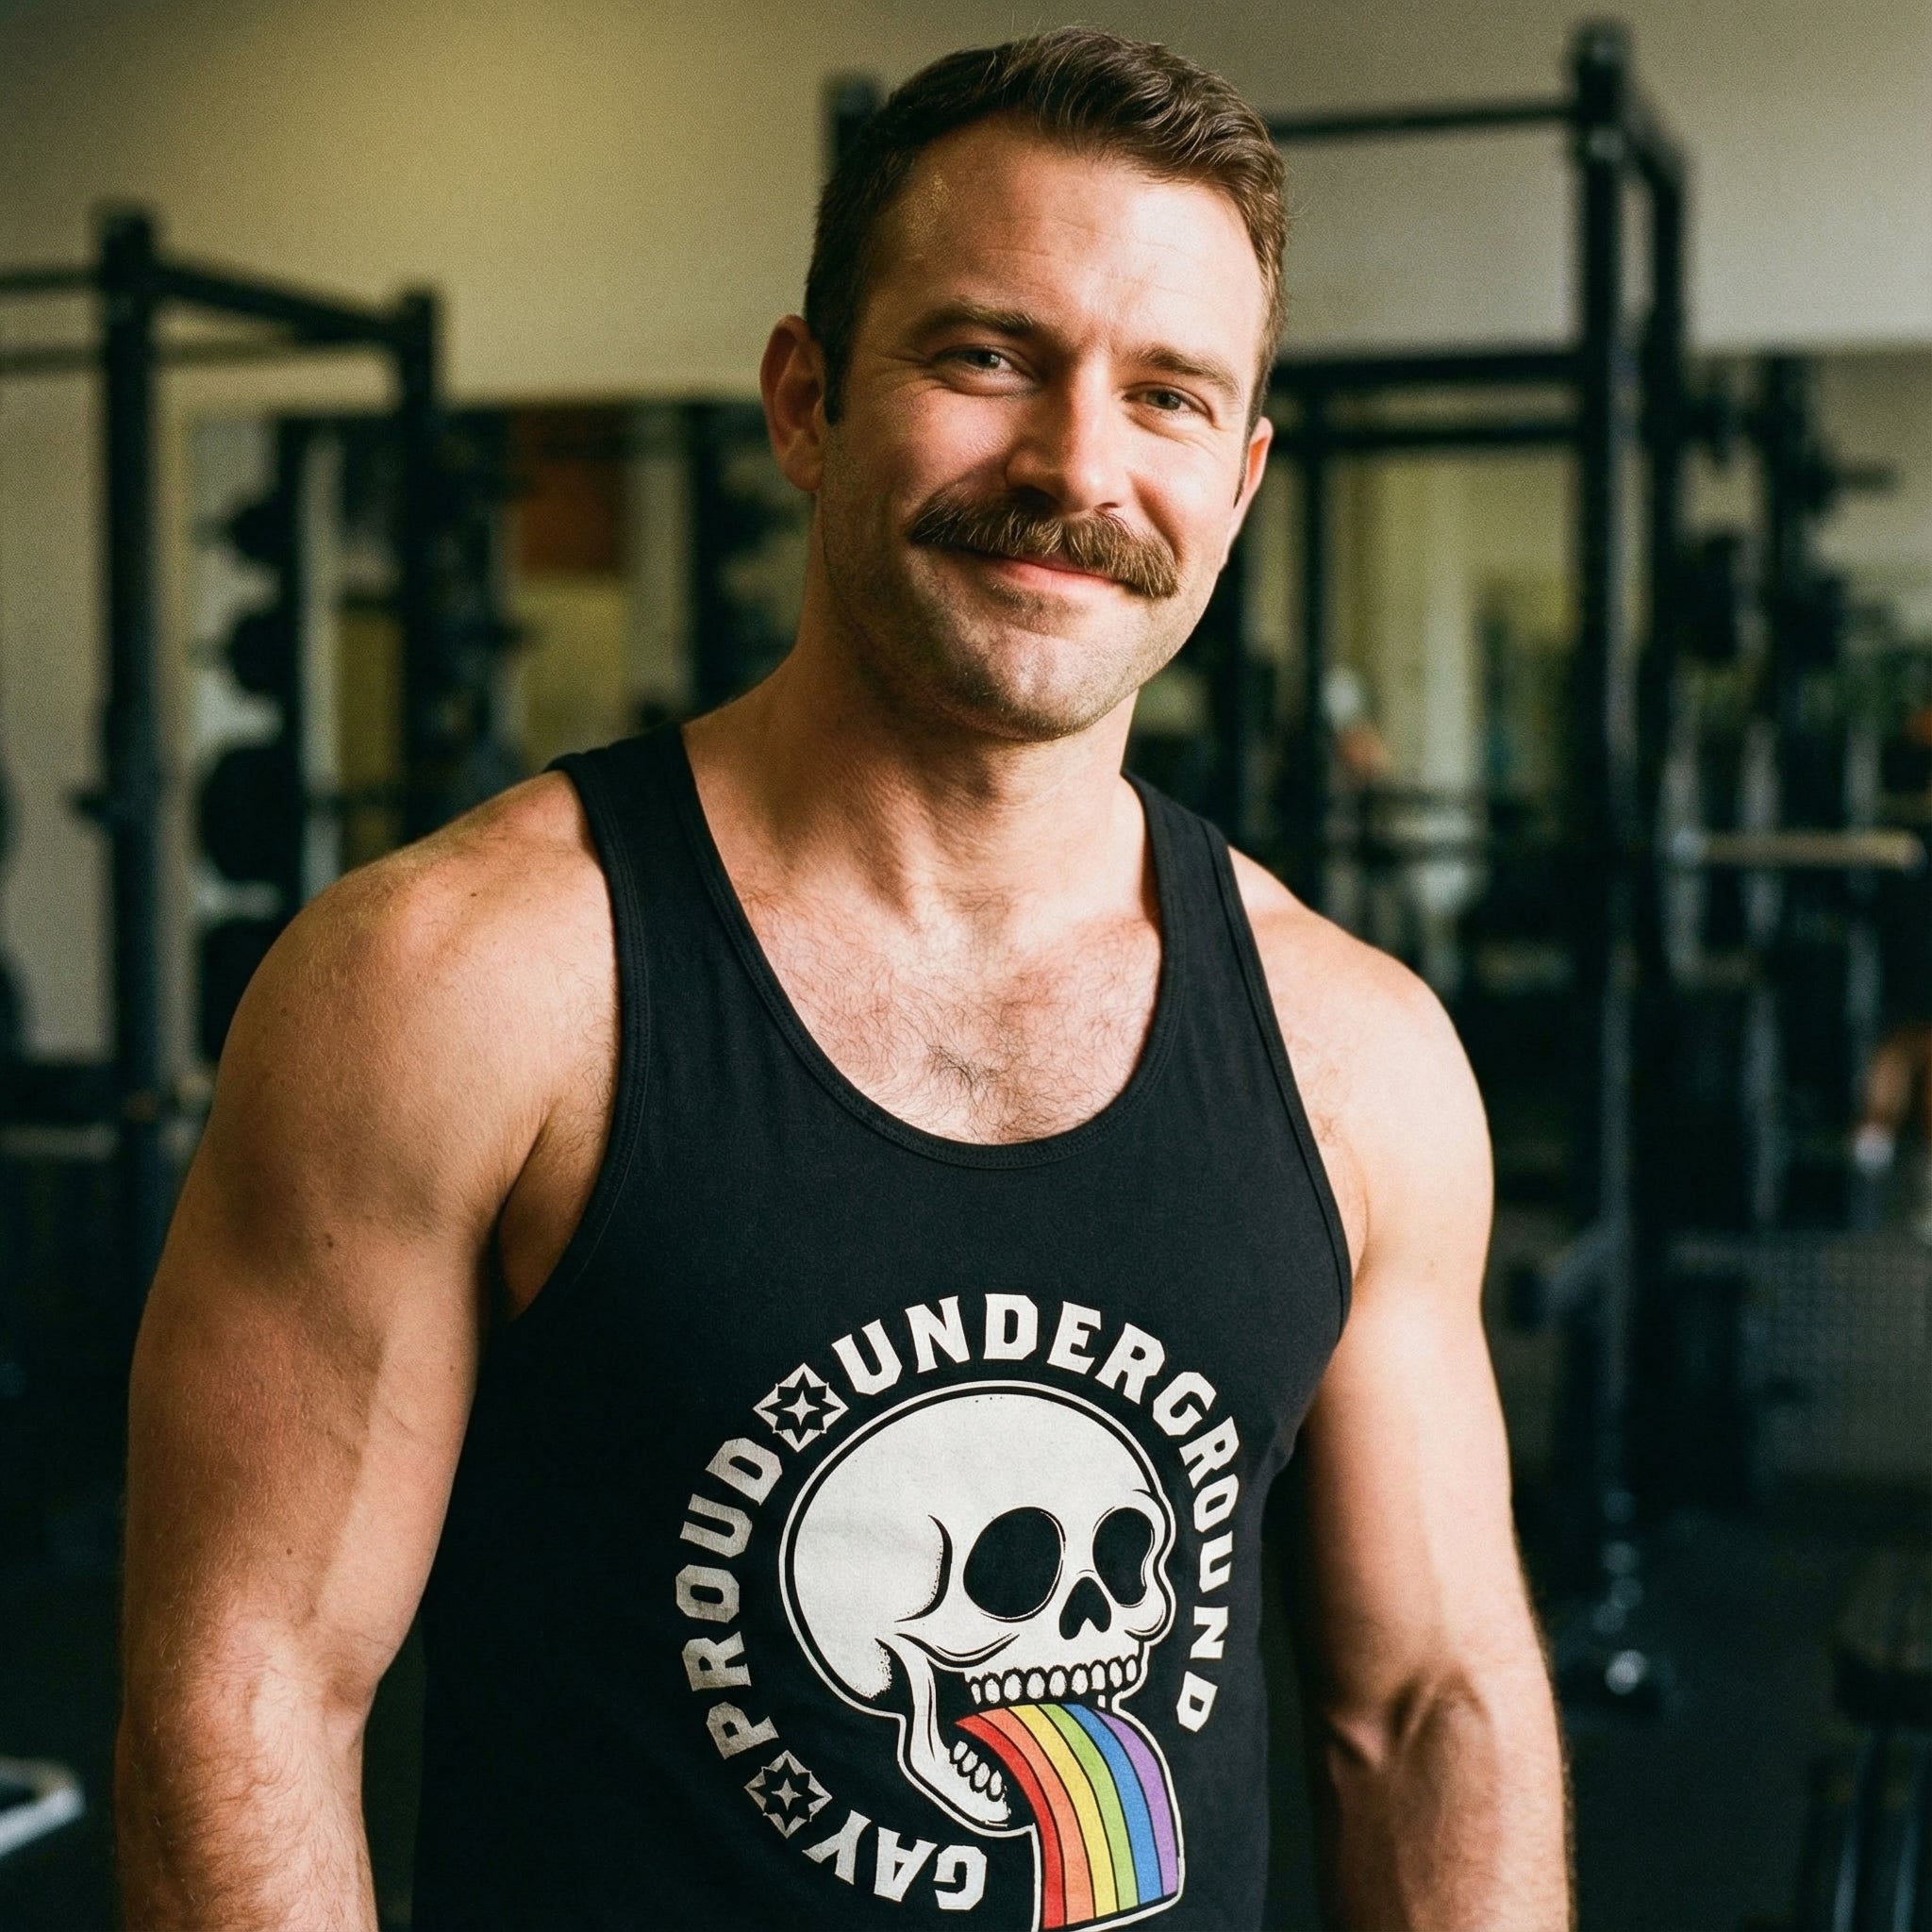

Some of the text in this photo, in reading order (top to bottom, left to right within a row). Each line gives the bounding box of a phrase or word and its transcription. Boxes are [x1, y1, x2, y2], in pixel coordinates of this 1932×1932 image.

[675, 1292, 1241, 1911] GAY PROUD UNDERGROUND
